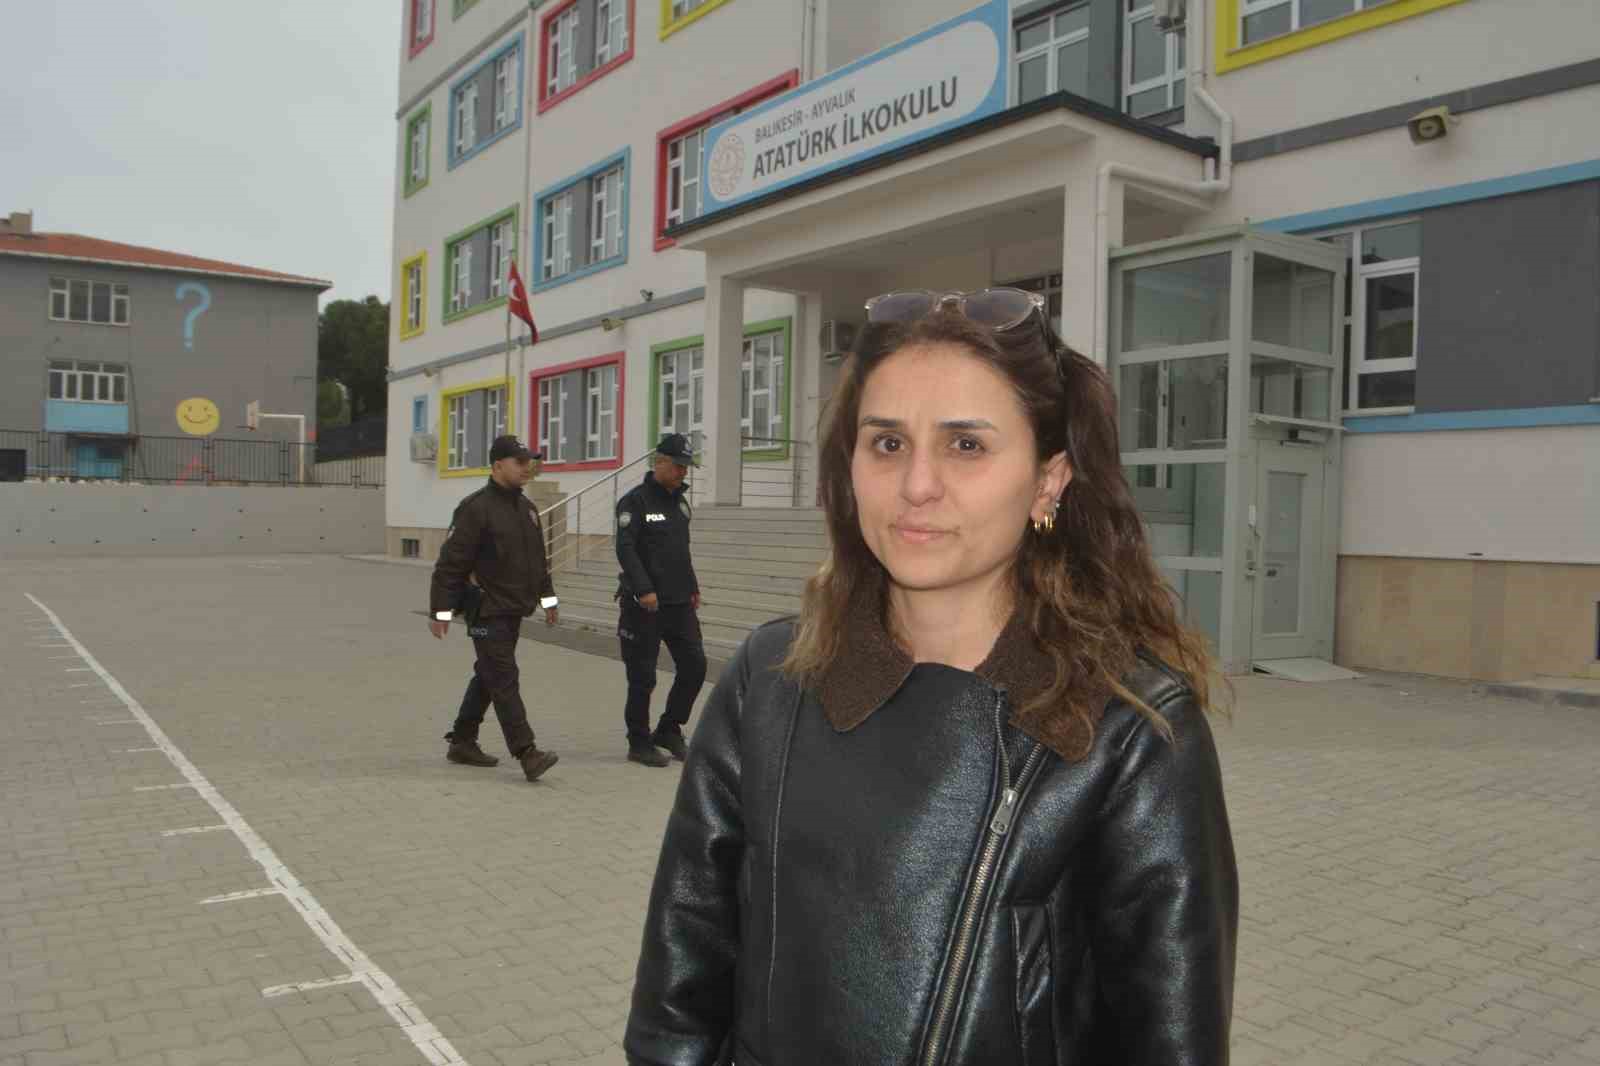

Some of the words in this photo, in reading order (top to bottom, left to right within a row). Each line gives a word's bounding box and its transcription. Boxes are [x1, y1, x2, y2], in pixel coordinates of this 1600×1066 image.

[753, 123, 837, 178] ATATÜRK
[842, 76, 958, 145] İLKOKULU
[811, 88, 856, 119] AYVALIK
